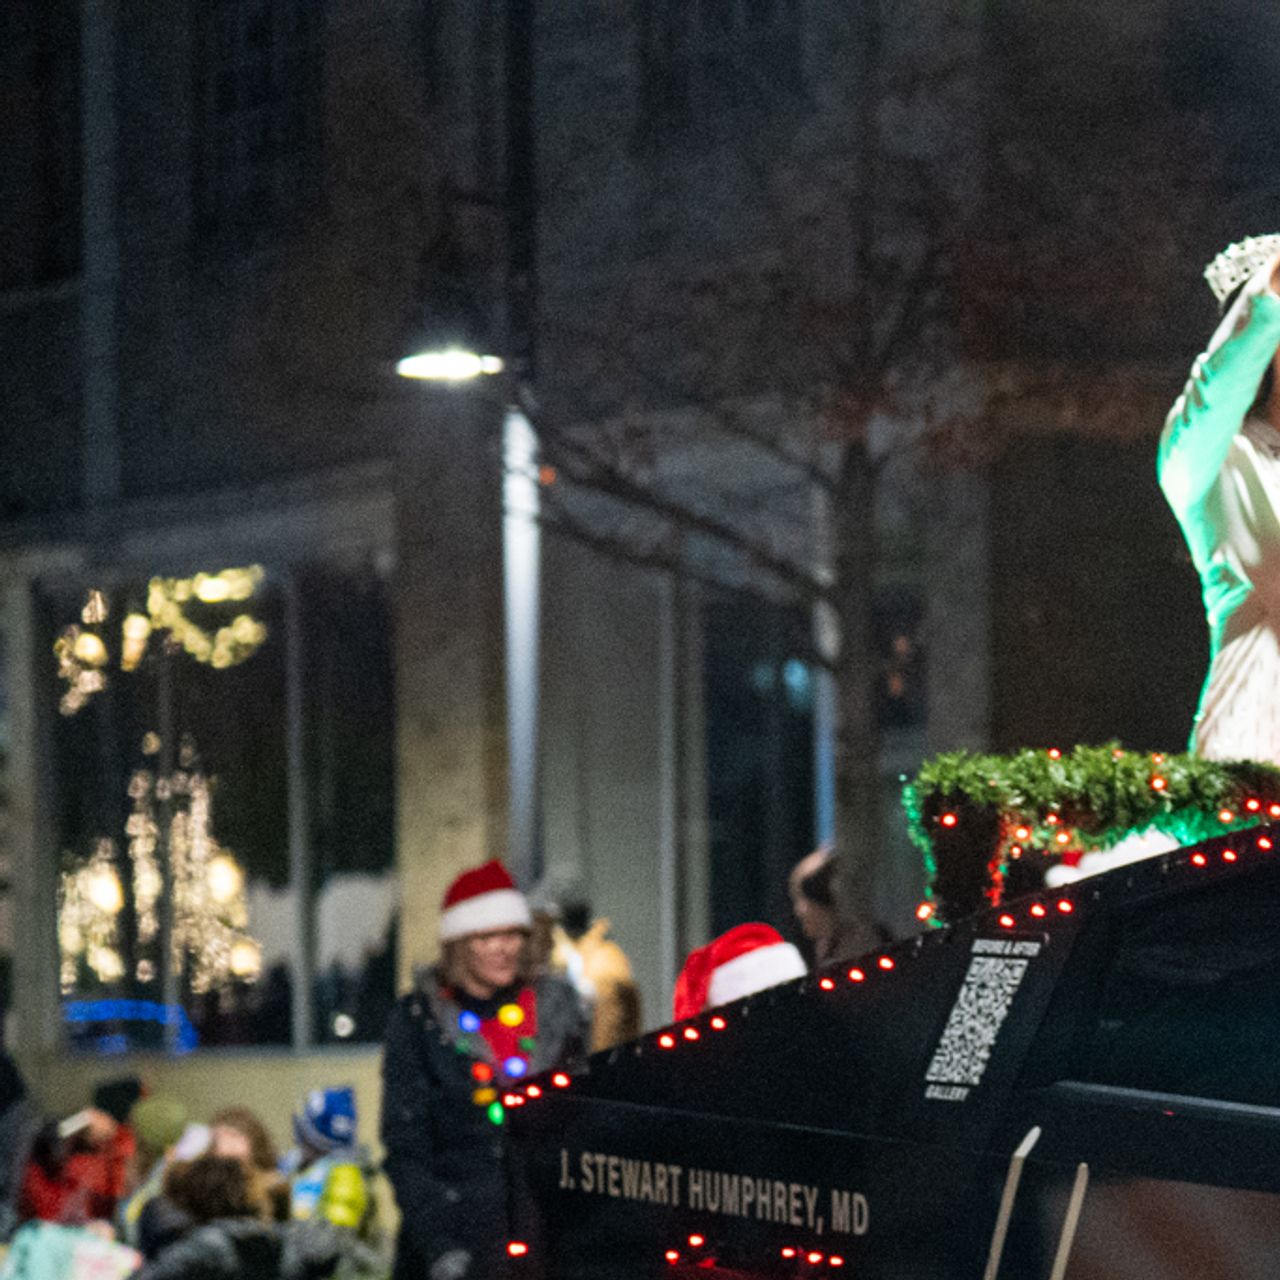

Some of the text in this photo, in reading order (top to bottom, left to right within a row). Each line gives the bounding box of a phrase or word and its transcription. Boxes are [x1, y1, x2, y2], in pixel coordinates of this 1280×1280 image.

[559, 1149, 870, 1237] J. STEWART HUMPHREY, MD
